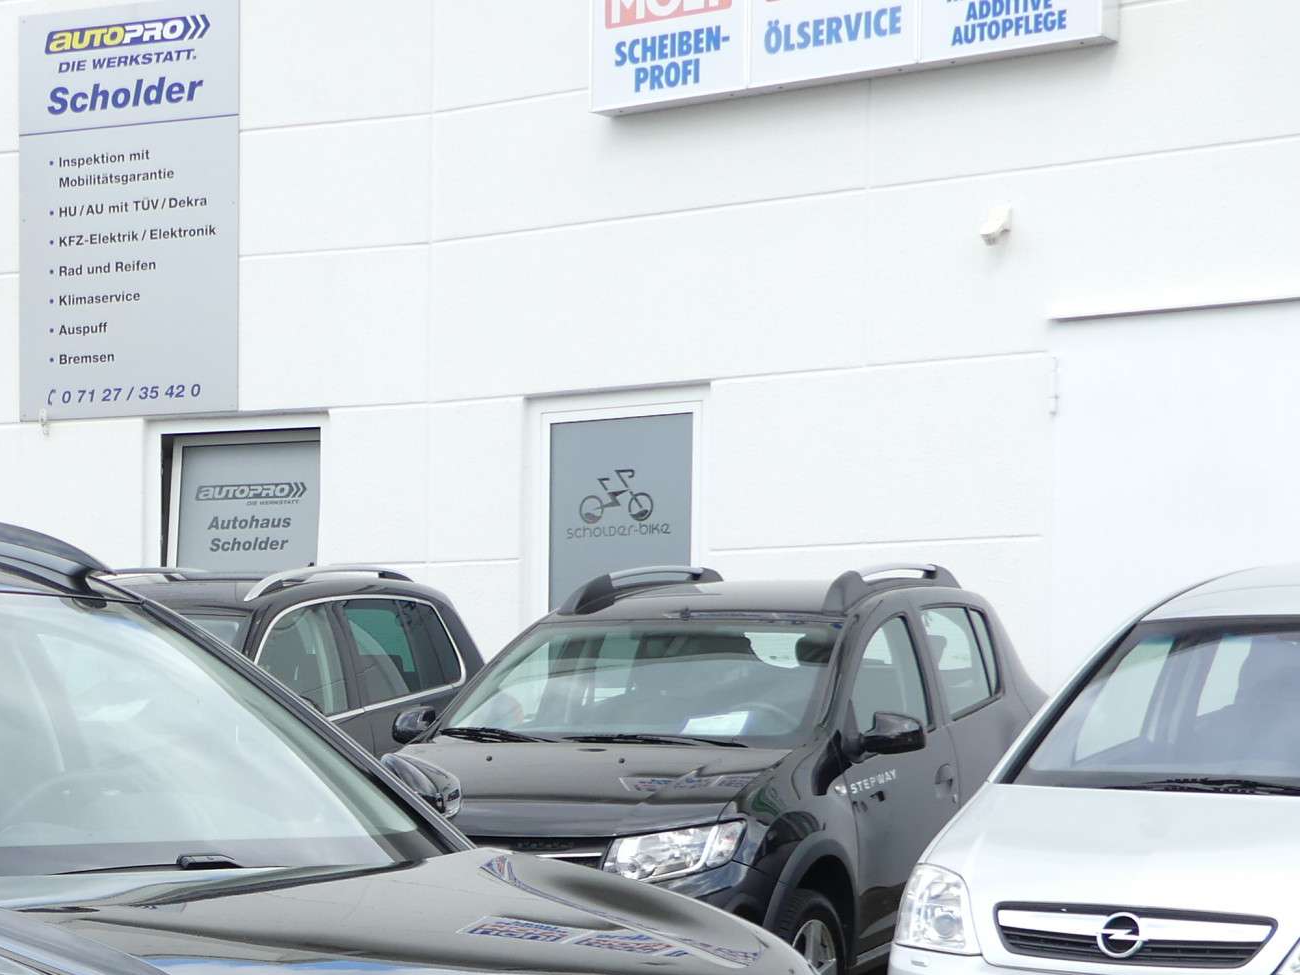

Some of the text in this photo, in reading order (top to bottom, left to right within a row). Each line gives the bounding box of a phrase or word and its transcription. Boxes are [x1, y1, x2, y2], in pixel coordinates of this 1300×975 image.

[764, 5, 902, 54] ÖLSERVICE
[952, 9, 1067, 46] AUTOPFLEGE
[615, 25, 730, 67] SCHEIBEN-
[58, 60, 87, 74] DIE
[634, 58, 701, 93] PROFI
[47, 77, 203, 115] Scholder
[58, 149, 150, 169] Inspektion mit
[58, 169, 175, 188] Mobilitätsgarantie
[109, 201, 129, 213] mit
[58, 259, 157, 277] Rad und Reifen
[58, 291, 141, 306] Klimaservice
[58, 322, 108, 336] Auspuff
[58, 352, 115, 365] Bremsen
[207, 515, 292, 530] Autohaus
[209, 537, 289, 552] Scholder
[850, 769, 896, 794] STEPWAY
